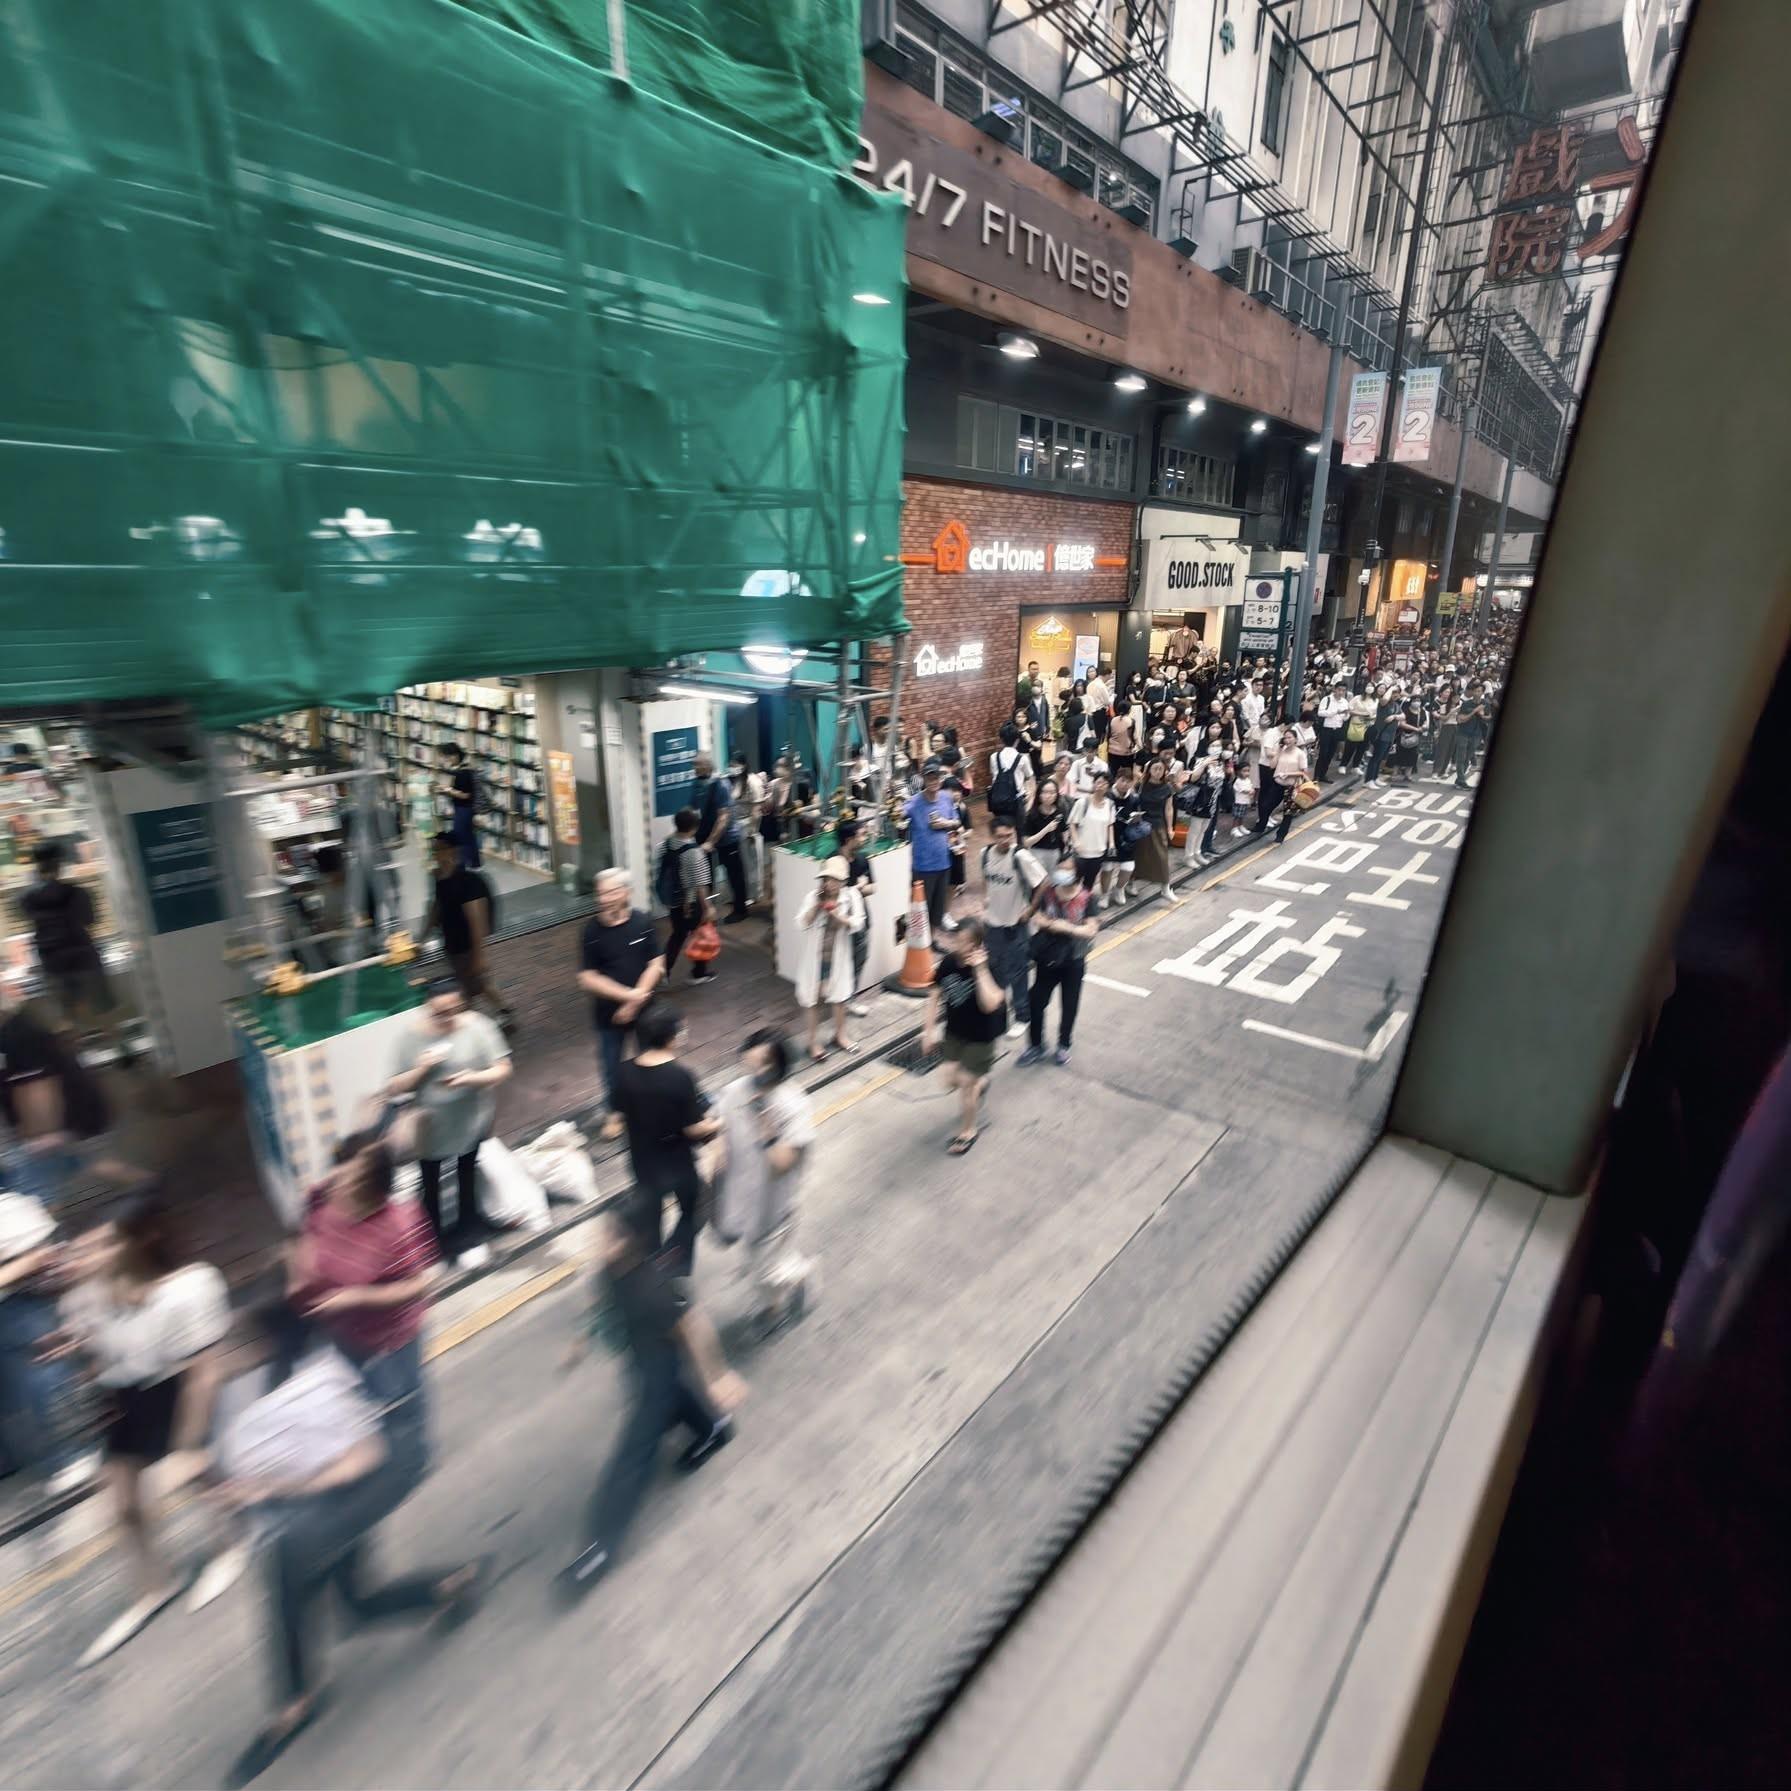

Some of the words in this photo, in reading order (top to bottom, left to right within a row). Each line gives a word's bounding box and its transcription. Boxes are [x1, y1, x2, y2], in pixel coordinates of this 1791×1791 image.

[981, 201, 1130, 308] FITNESS
[1350, 413, 1376, 445] 2
[1402, 410, 1429, 442] 2
[969, 541, 1045, 571] ecHome
[1168, 560, 1235, 589] GOOD.STOCK
[1255, 836, 1441, 911] 巴士
[1151, 900, 1367, 1005] 站
